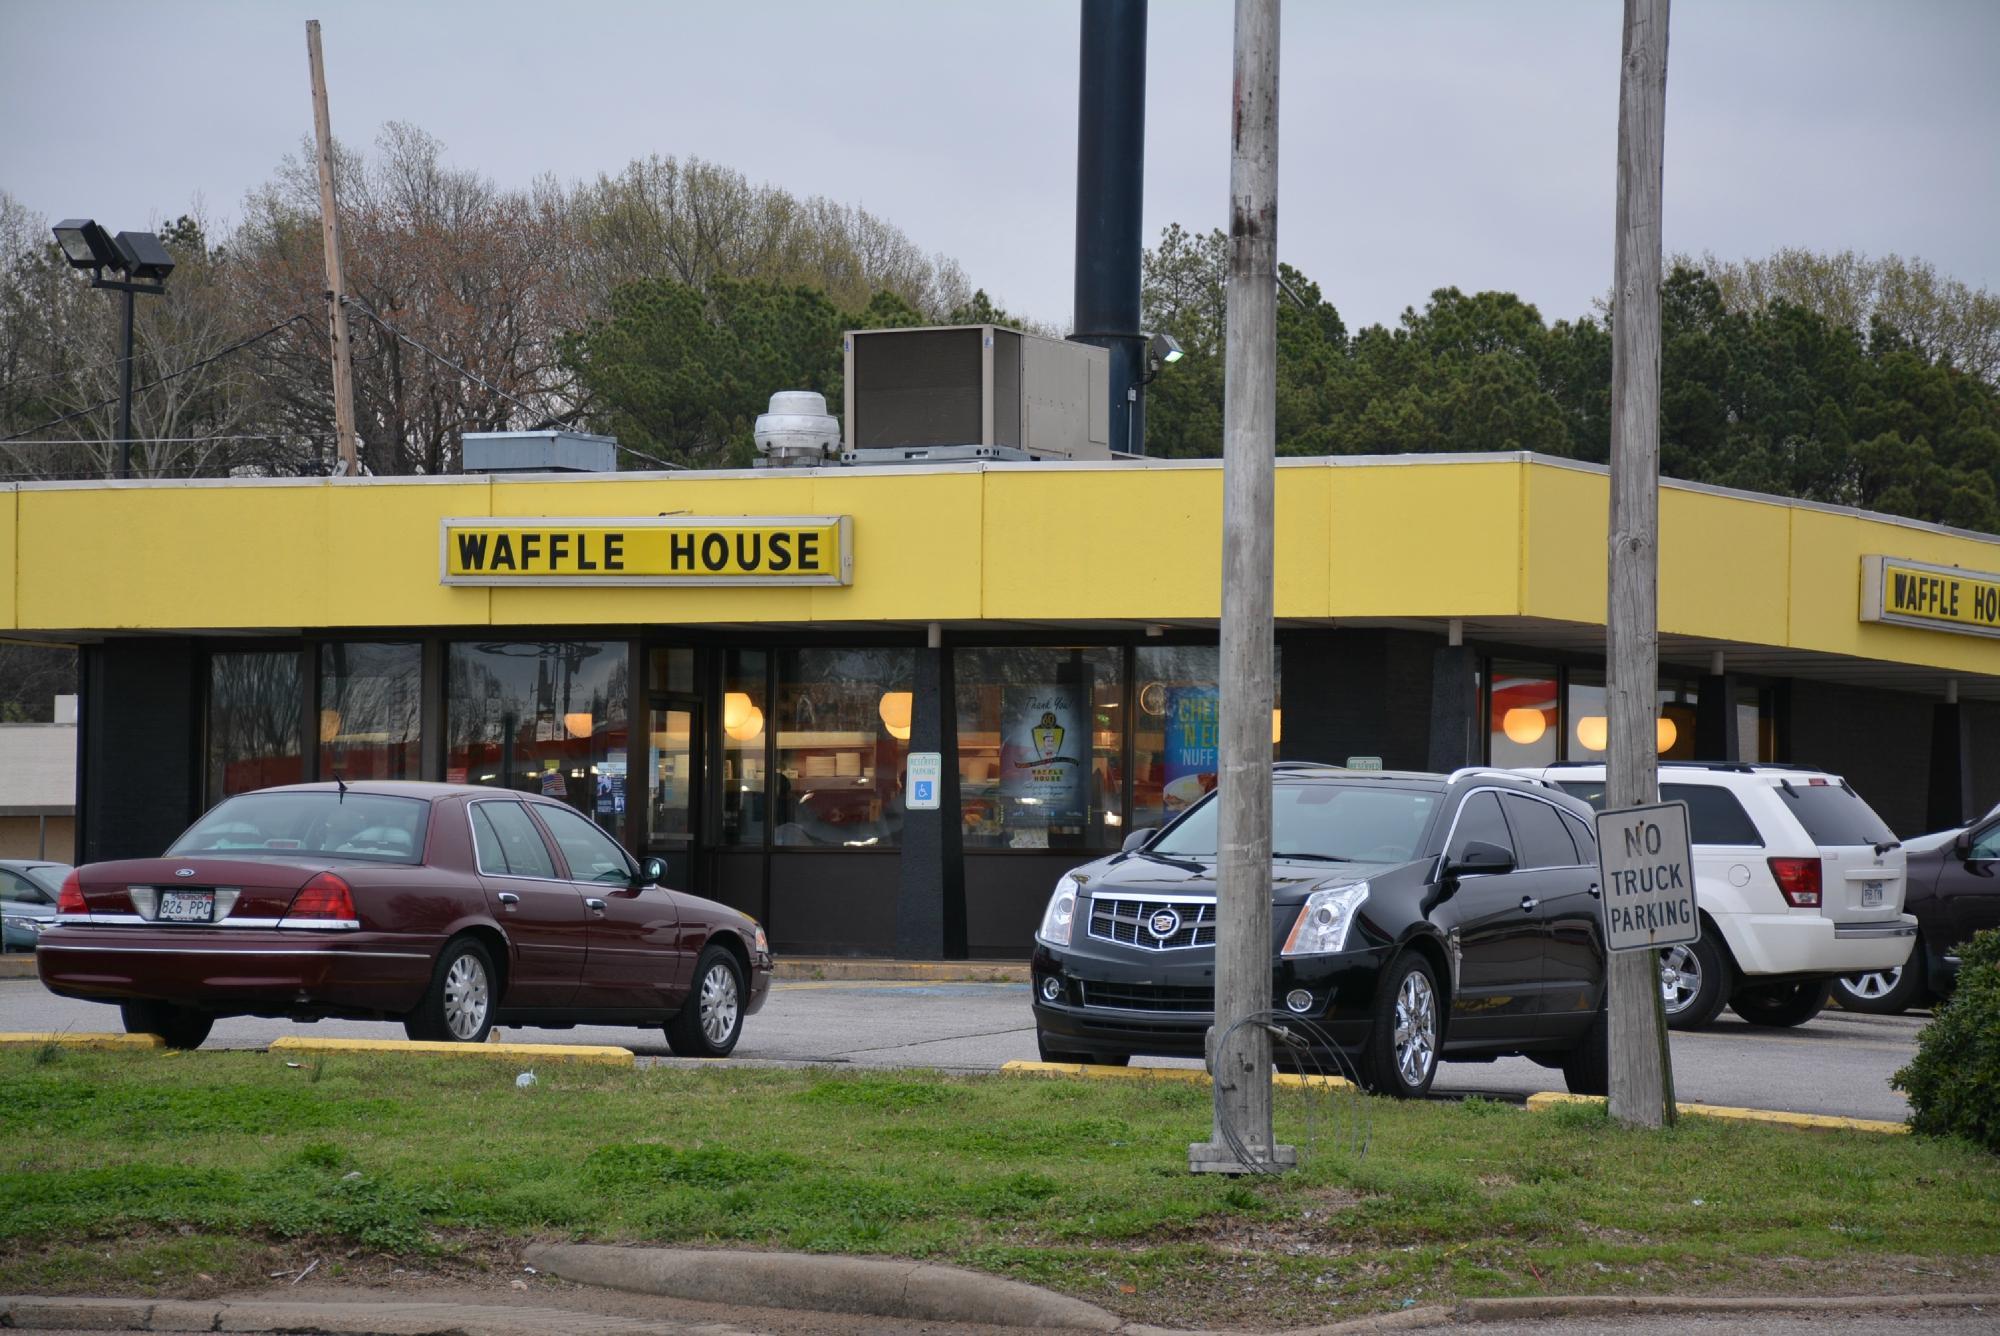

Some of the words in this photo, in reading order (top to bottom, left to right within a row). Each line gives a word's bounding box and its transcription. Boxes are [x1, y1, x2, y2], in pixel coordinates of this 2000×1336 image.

[457, 532, 624, 571] WAFFLE
[670, 532, 819, 571] HOUSE
[1894, 573, 1959, 617] WAFFLE
[1974, 585, 2000, 623] HO
[1179, 748, 1214, 767] 'NUFF
[1624, 823, 1662, 858] NO
[1611, 863, 1684, 897] TRUCK
[161, 900, 182, 914] 826
[189, 901, 211, 915] PPC
[1611, 898, 1690, 934] PARKING
